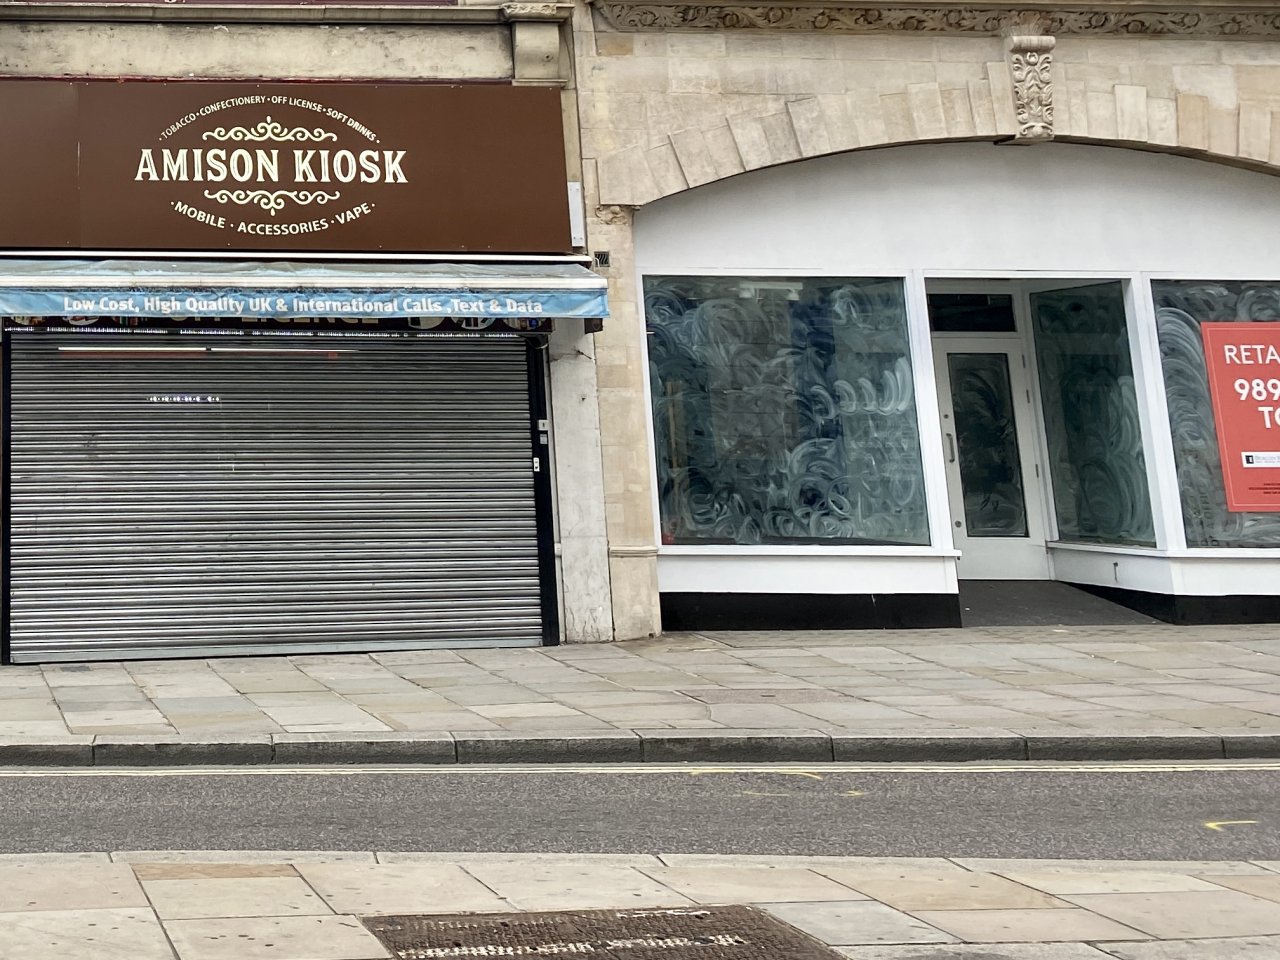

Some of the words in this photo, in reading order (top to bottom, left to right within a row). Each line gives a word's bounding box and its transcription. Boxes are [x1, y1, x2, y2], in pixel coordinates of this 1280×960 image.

[160, 112, 197, 140] TOBACCO
[199, 95, 266, 117] CONFECTIONERY
[271, 95, 288, 105] OFF
[289, 97, 323, 113] LICENSE
[326, 107, 349, 124] SOFT
[346, 117, 377, 142] DRINKS
[134, 148, 280, 183] AMISON
[294, 149, 409, 184] KIOSK
[173, 200, 227, 229] MOBILE
[236, 218, 330, 236] ACCESSORIES
[334, 202, 372, 225] VAPE
[63, 297, 96, 311] Low
[99, 296, 140, 313] Cost,
[144, 296, 181, 314] High
[185, 296, 245, 315] Quality
[248, 297, 272, 312] UK
[275, 298, 289, 312] &
[292, 297, 399, 313] International
[402, 297, 443, 313] Calls
[489, 299, 503, 313] &
[505, 298, 544, 314] Data
